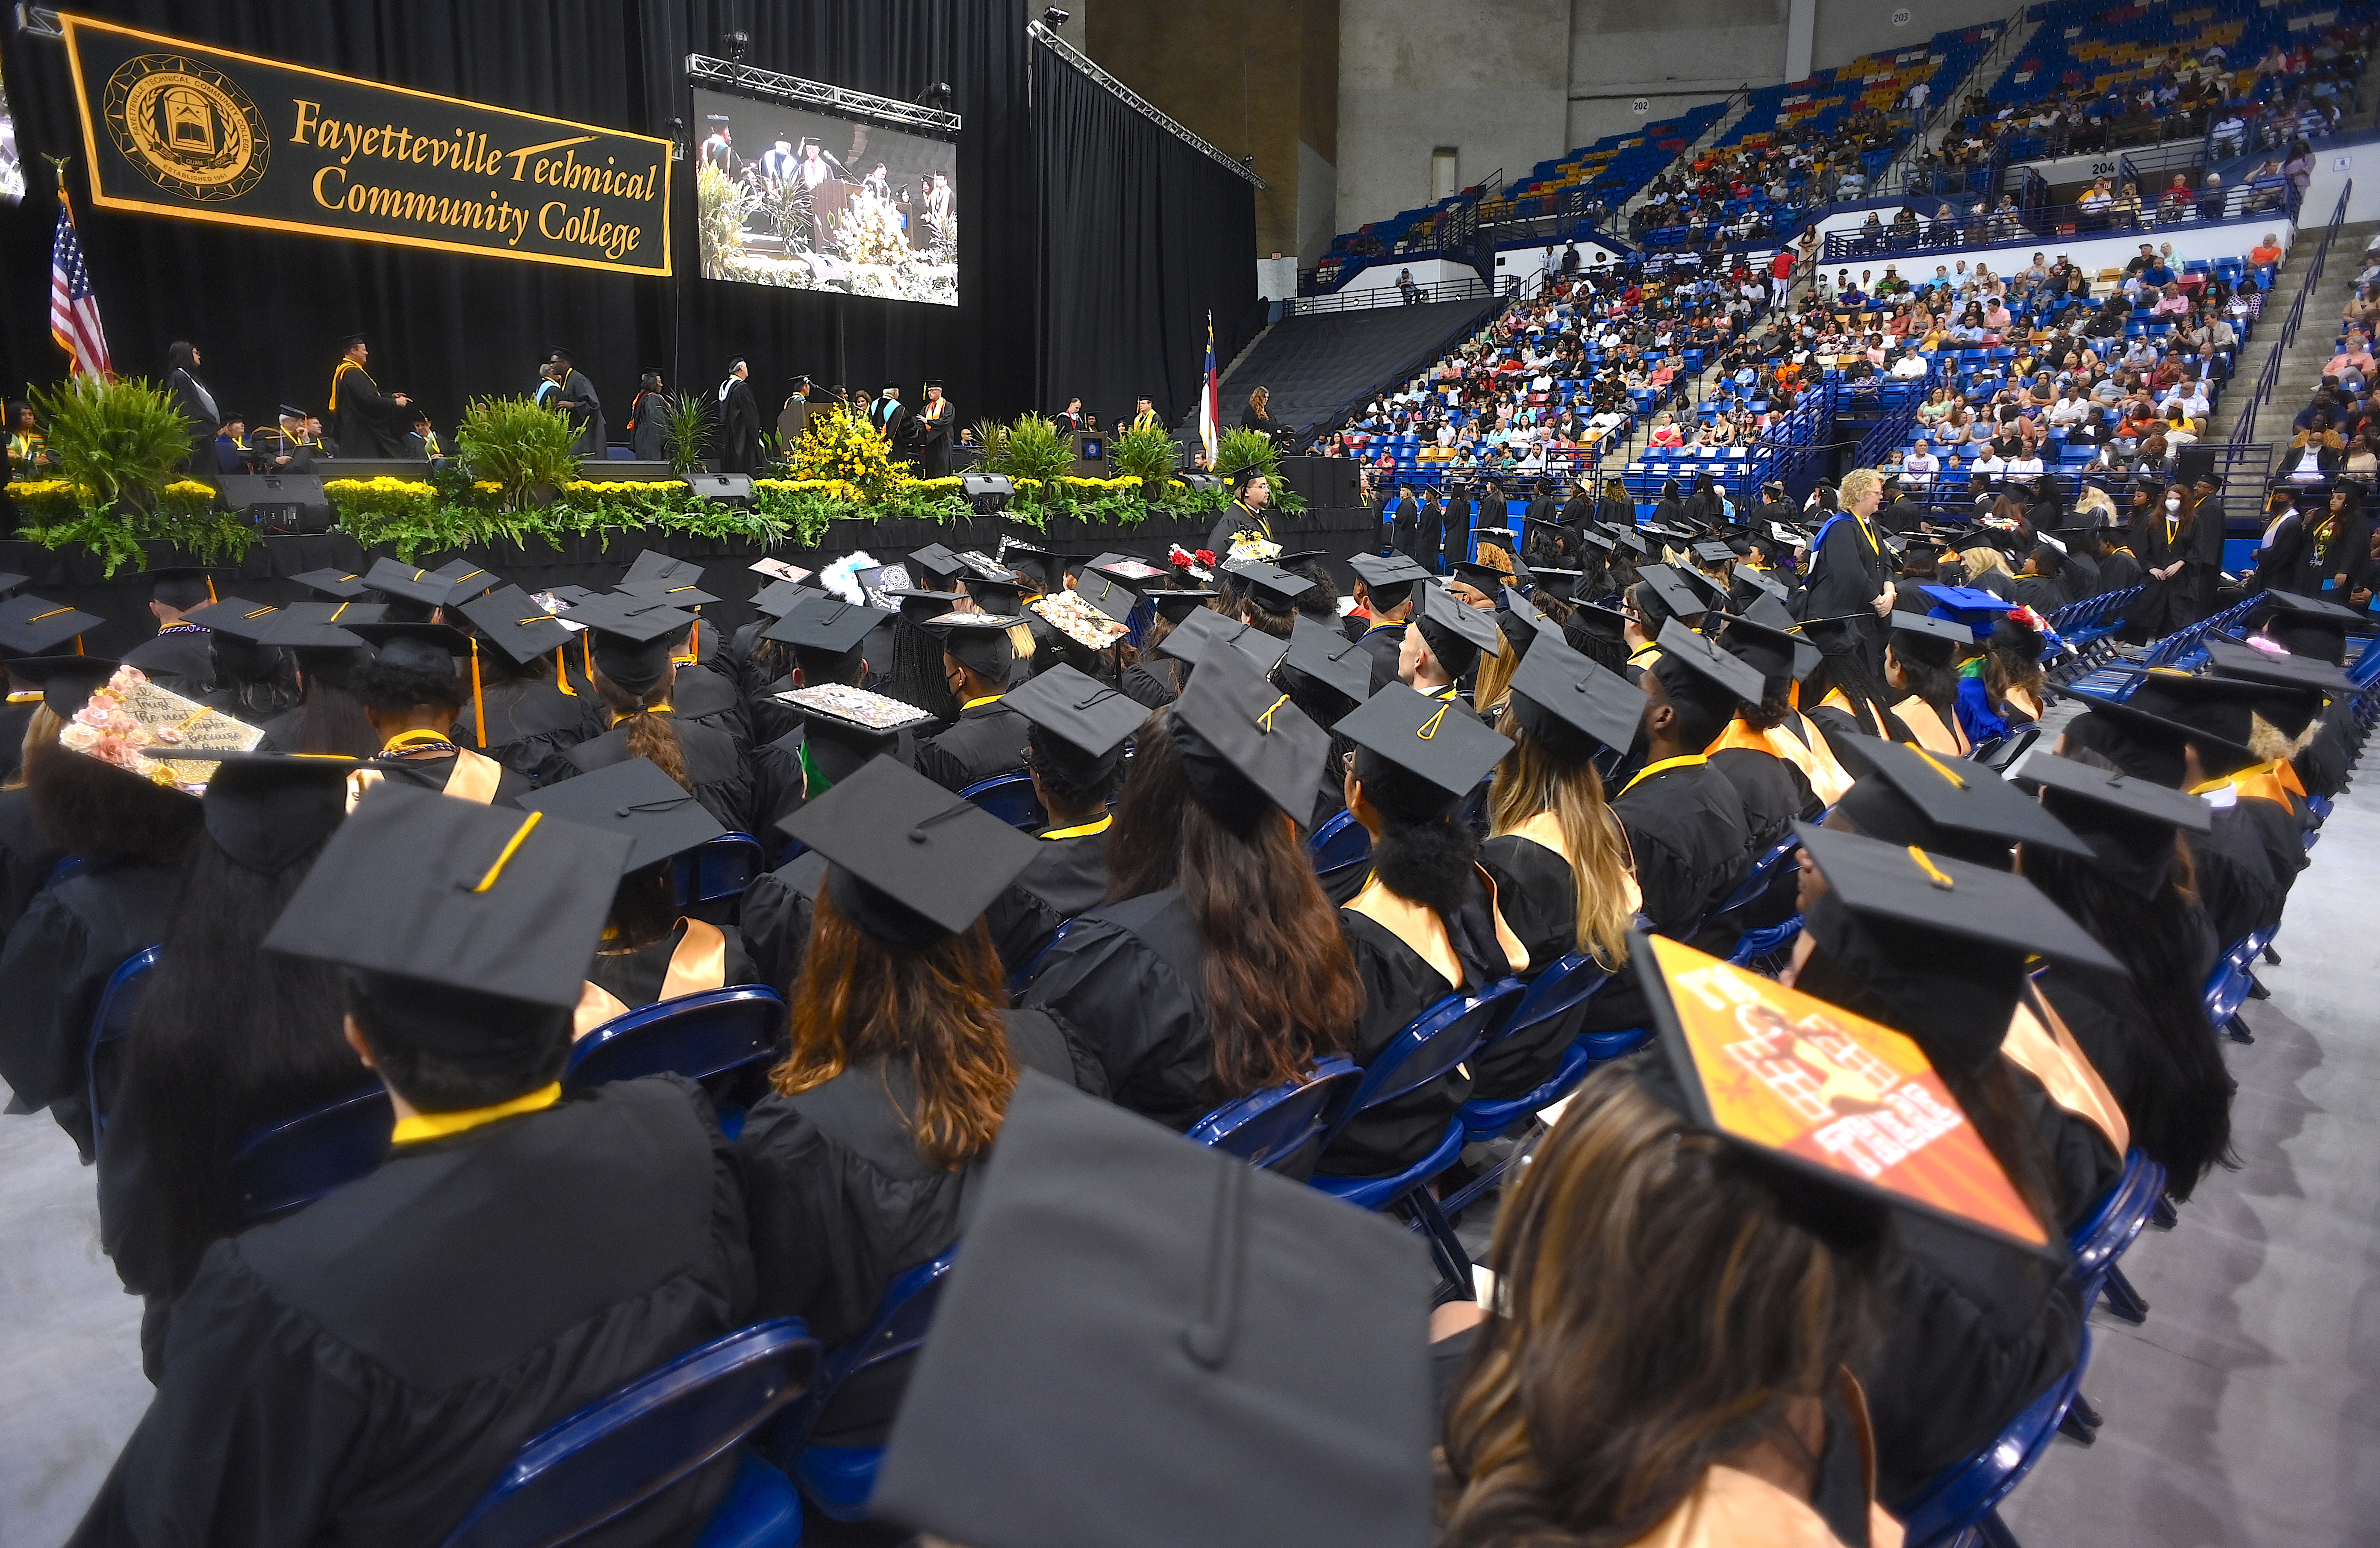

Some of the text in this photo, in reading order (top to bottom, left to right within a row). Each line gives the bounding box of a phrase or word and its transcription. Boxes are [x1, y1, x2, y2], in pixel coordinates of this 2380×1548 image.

[1894, 12, 1908, 22] 203
[129, 74, 249, 154] FAYETTEVILLE TECHNICAL COMMUNITY COLLEGE
[1634, 101, 1647, 110] 202
[160, 147, 228, 166] ESSE QUAM VIDERI
[289, 99, 657, 202] Fayetteville Technical
[163, 164, 212, 182] ESTABLISHED
[2092, 162, 2115, 174] 204
[312, 166, 641, 260] Community College
